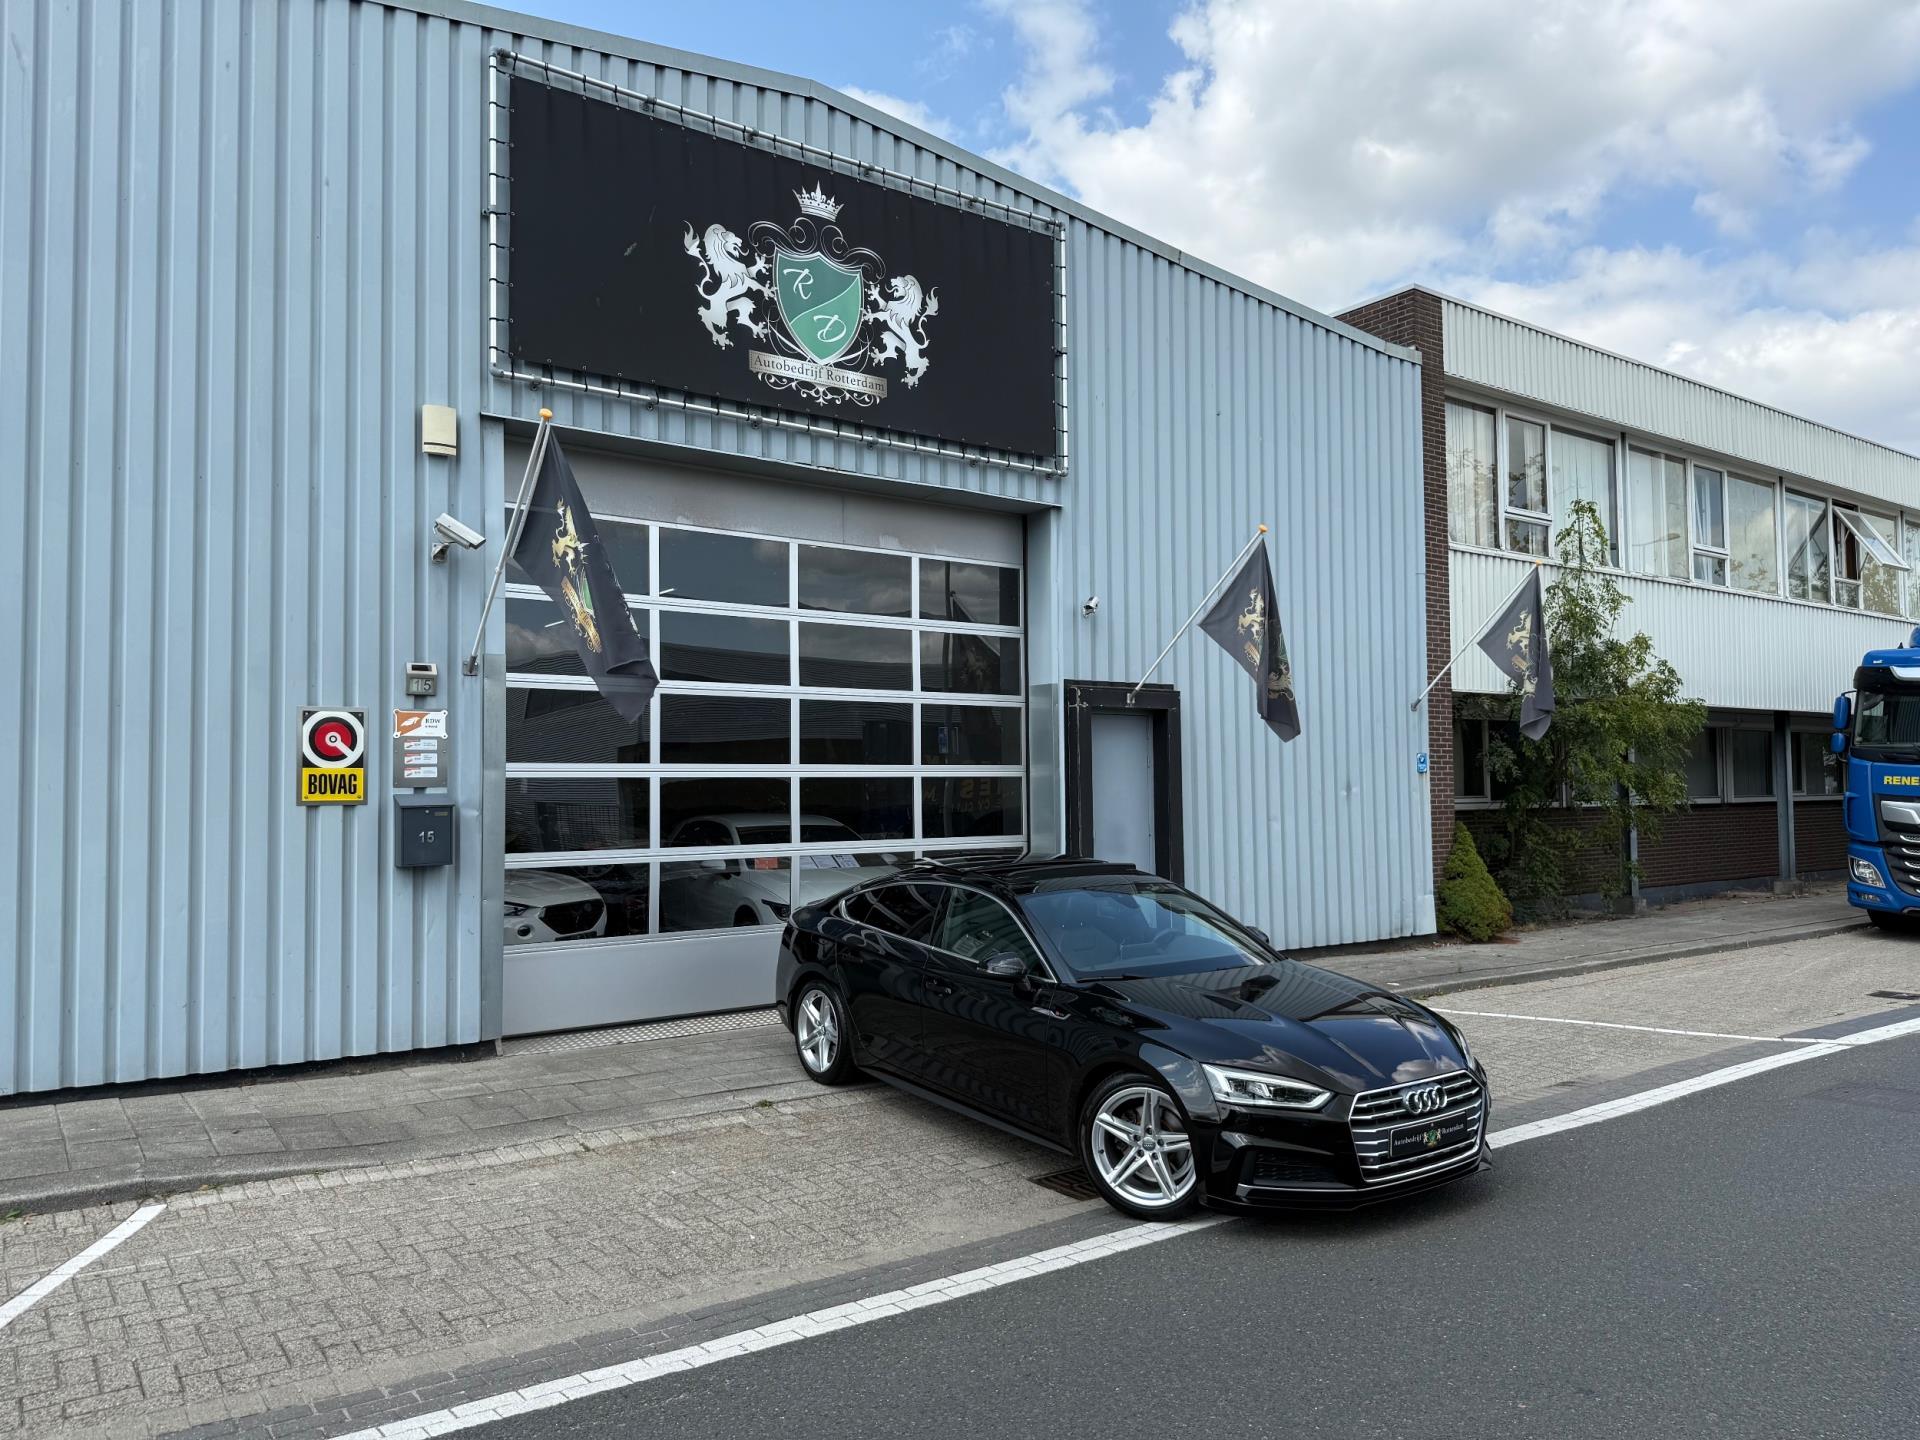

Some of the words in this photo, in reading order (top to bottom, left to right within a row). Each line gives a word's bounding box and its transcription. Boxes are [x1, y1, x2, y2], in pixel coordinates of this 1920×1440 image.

[783, 268, 813, 300] R
[754, 355, 823, 379] Autobedrijf
[827, 369, 885, 391] Rotterdam
[414, 679, 431, 691] 15
[308, 773, 358, 795] BOVAG
[418, 830, 435, 843] 15
